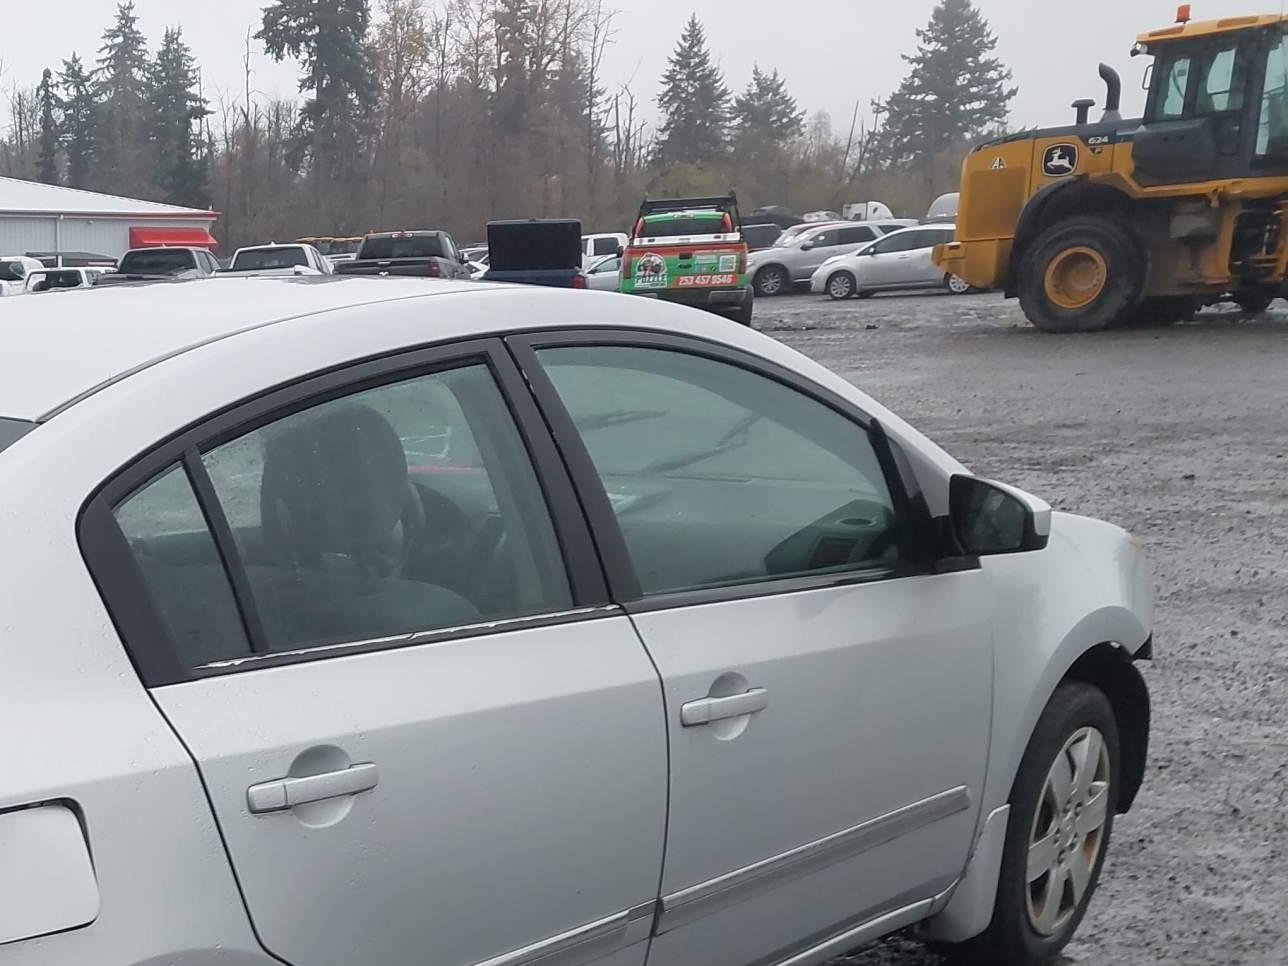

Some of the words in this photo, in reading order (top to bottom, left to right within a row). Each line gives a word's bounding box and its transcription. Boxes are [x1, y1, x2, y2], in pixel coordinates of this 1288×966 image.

[1088, 136, 1109, 145] 624
[679, 276, 695, 286] 253
[695, 275, 712, 285] 457
